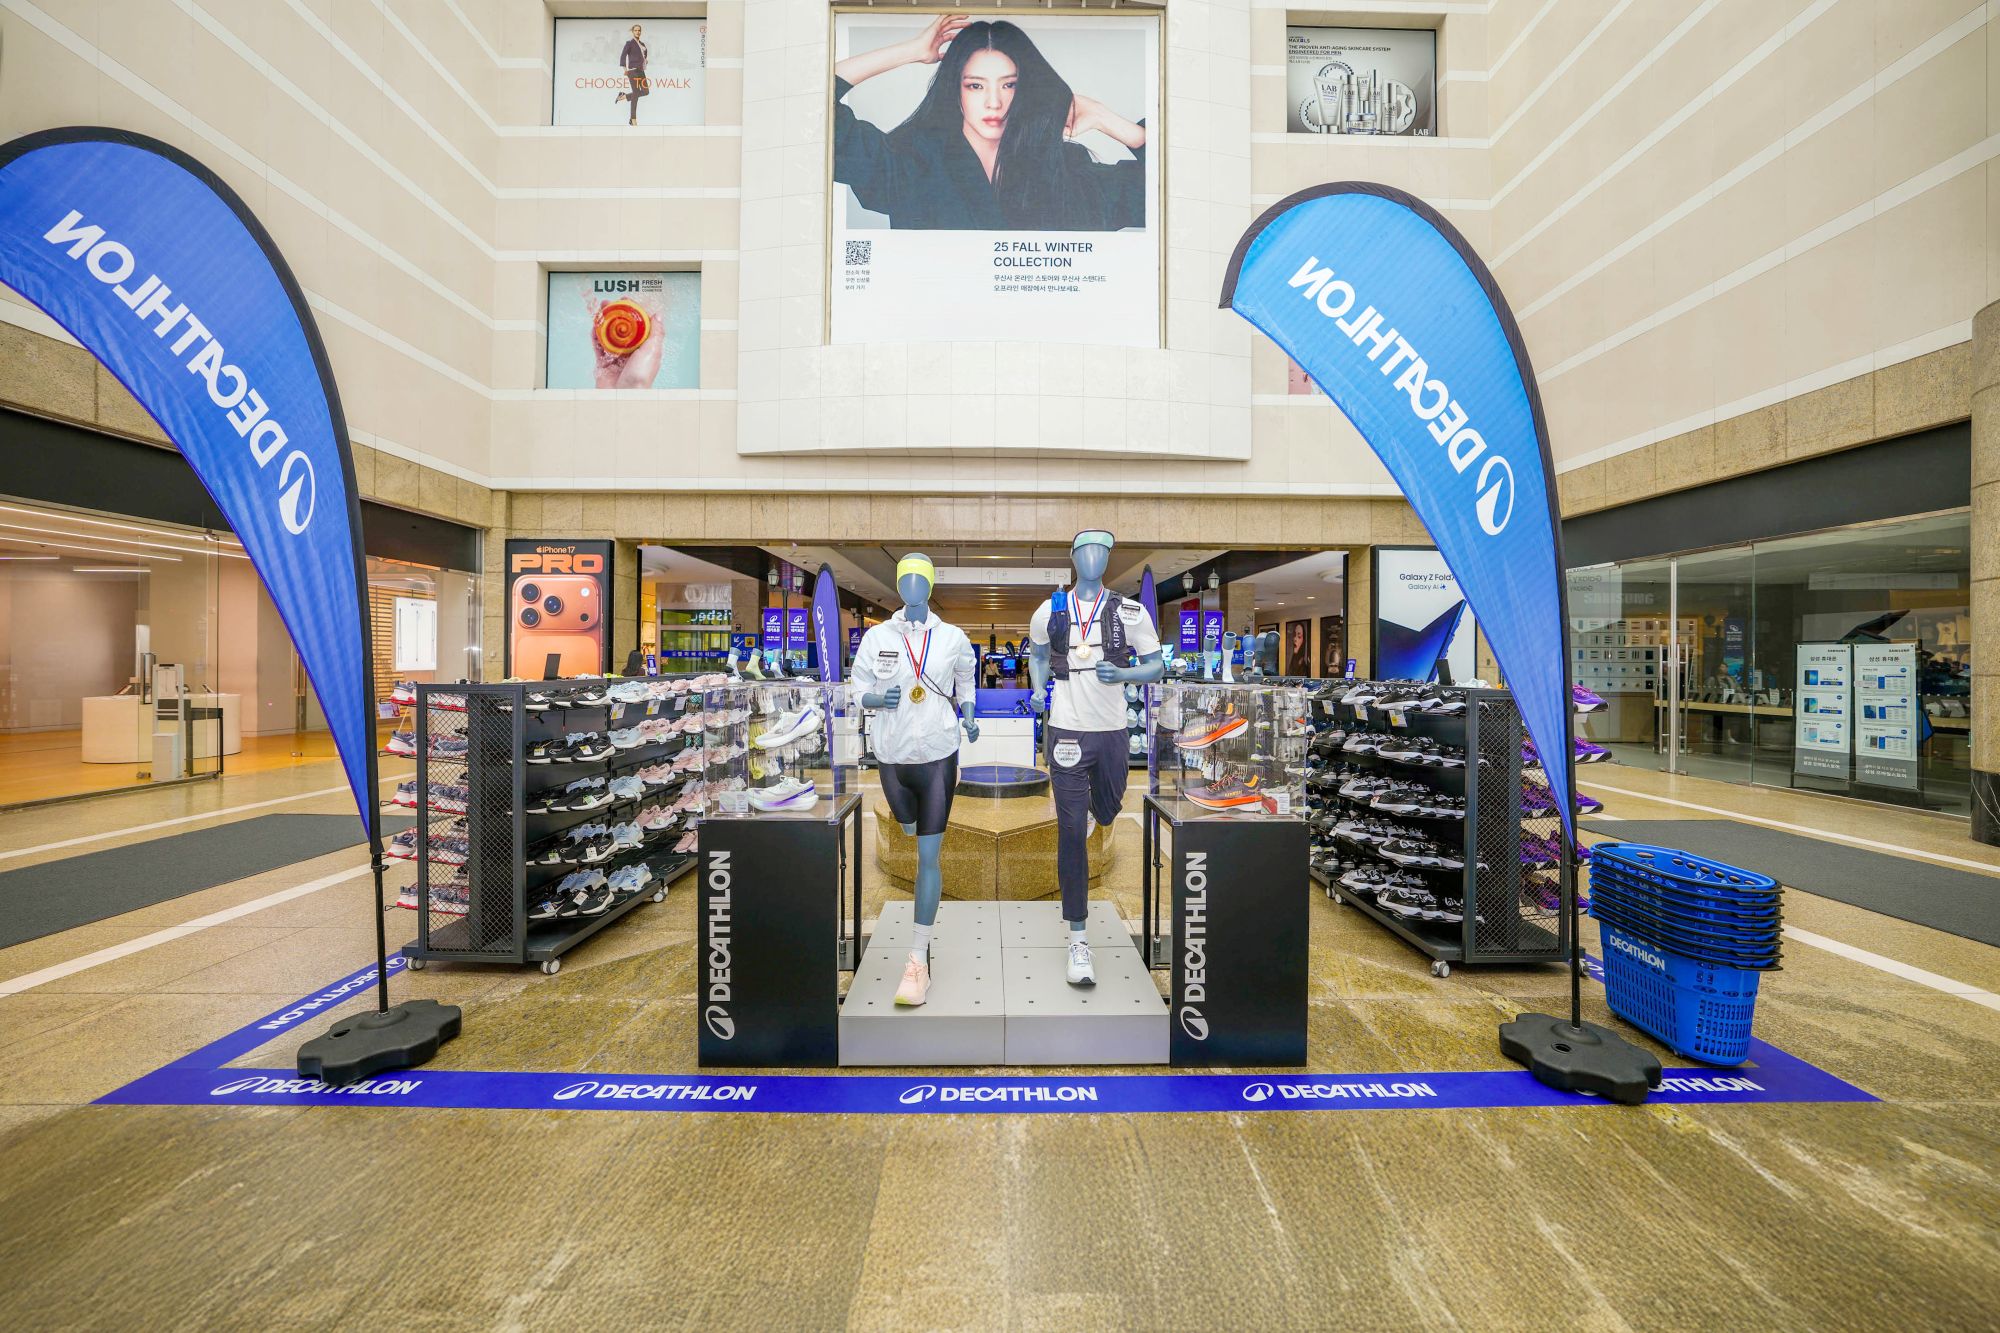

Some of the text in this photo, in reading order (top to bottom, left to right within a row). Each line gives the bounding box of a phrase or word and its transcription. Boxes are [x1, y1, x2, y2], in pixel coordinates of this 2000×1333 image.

[575, 77, 691, 89] CHOOSE TO WALK
[1321, 84, 1337, 93] LAB
[1413, 128, 1429, 136] LAB
[993, 241, 1093, 252] 25 FALL WINTER
[993, 256, 1072, 268] COLLECTION
[594, 280, 640, 292] LUSH
[542, 546, 567, 554] iPhone
[512, 554, 604, 573] PRO
[1399, 573, 1428, 582] Galaxy
[1408, 583, 1431, 591] Galaxy
[1112, 612, 1121, 648] KIPRUN
[709, 850, 731, 1002] DECATHLON
[1184, 852, 1207, 1002] DECATHLON
[1609, 934, 1665, 972] DECATHLON
[594, 1084, 757, 1100] DECATHLON
[940, 1086, 1098, 1102] DECATHLON
[1278, 1083, 1437, 1099] DECATHLON
